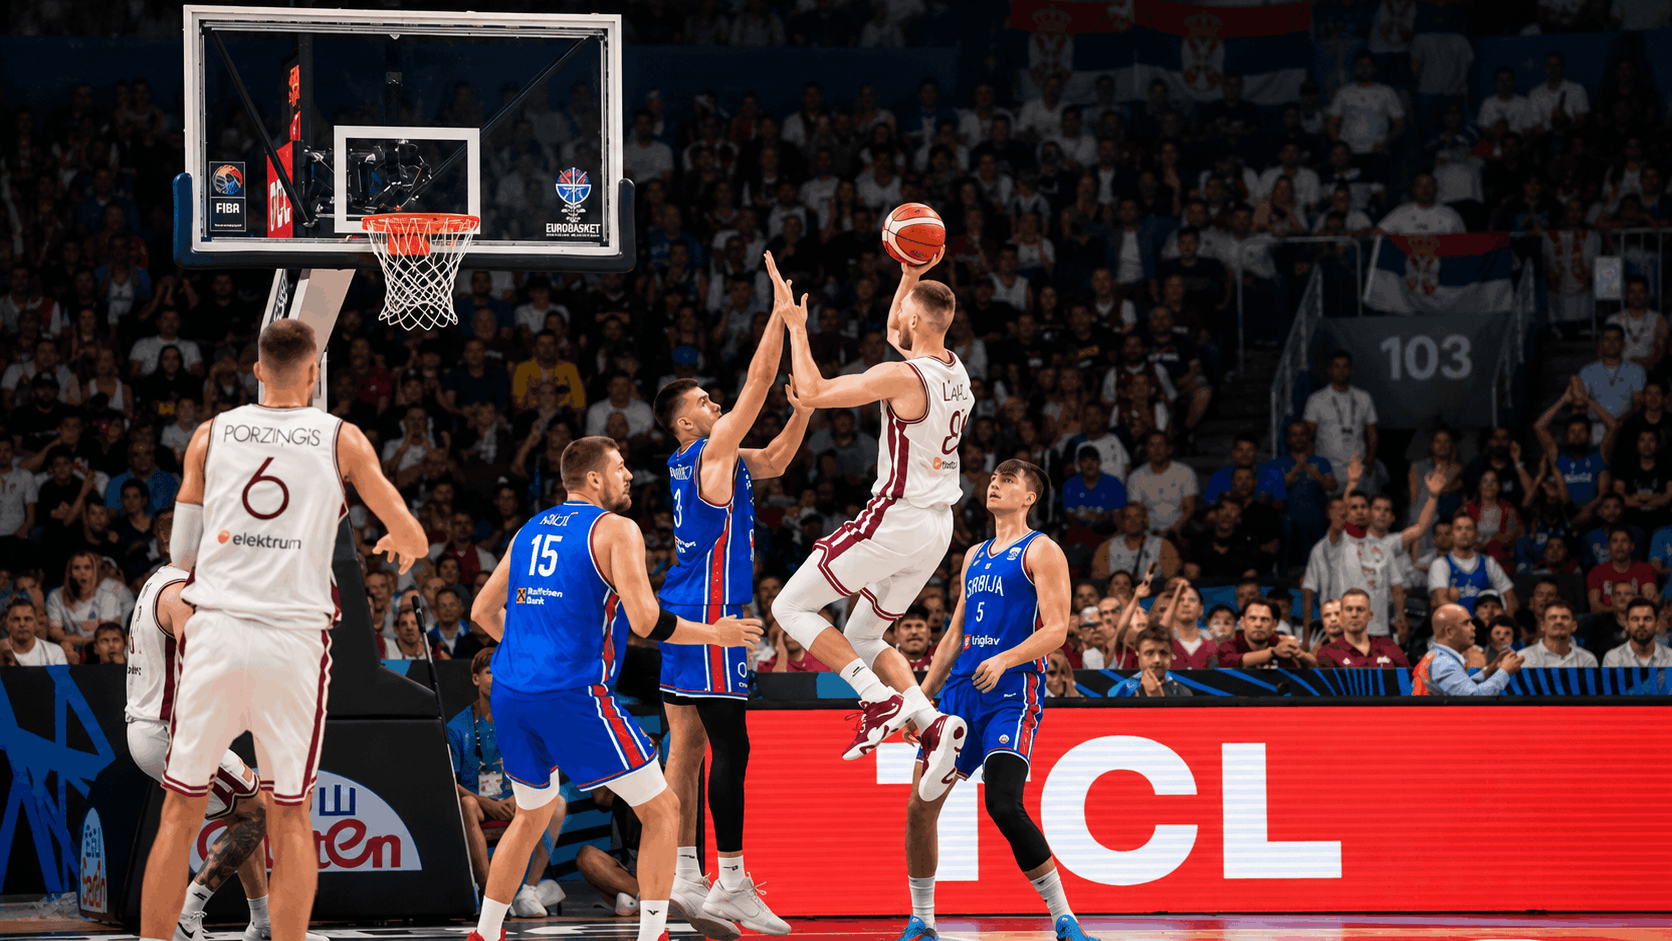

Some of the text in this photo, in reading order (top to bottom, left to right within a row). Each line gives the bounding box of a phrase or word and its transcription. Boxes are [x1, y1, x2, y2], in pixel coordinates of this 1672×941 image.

[215, 202, 240, 214] FIBA
[545, 222, 601, 234] EUROBASKET
[1380, 334, 1473, 381] 103
[242, 457, 290, 520] 6
[232, 532, 302, 549] elektrum
[528, 534, 563, 577] 15
[967, 574, 1004, 598] SRBIJA
[975, 601, 985, 622] 5
[971, 635, 1000, 648] triglav
[876, 734, 1342, 886] TCL
